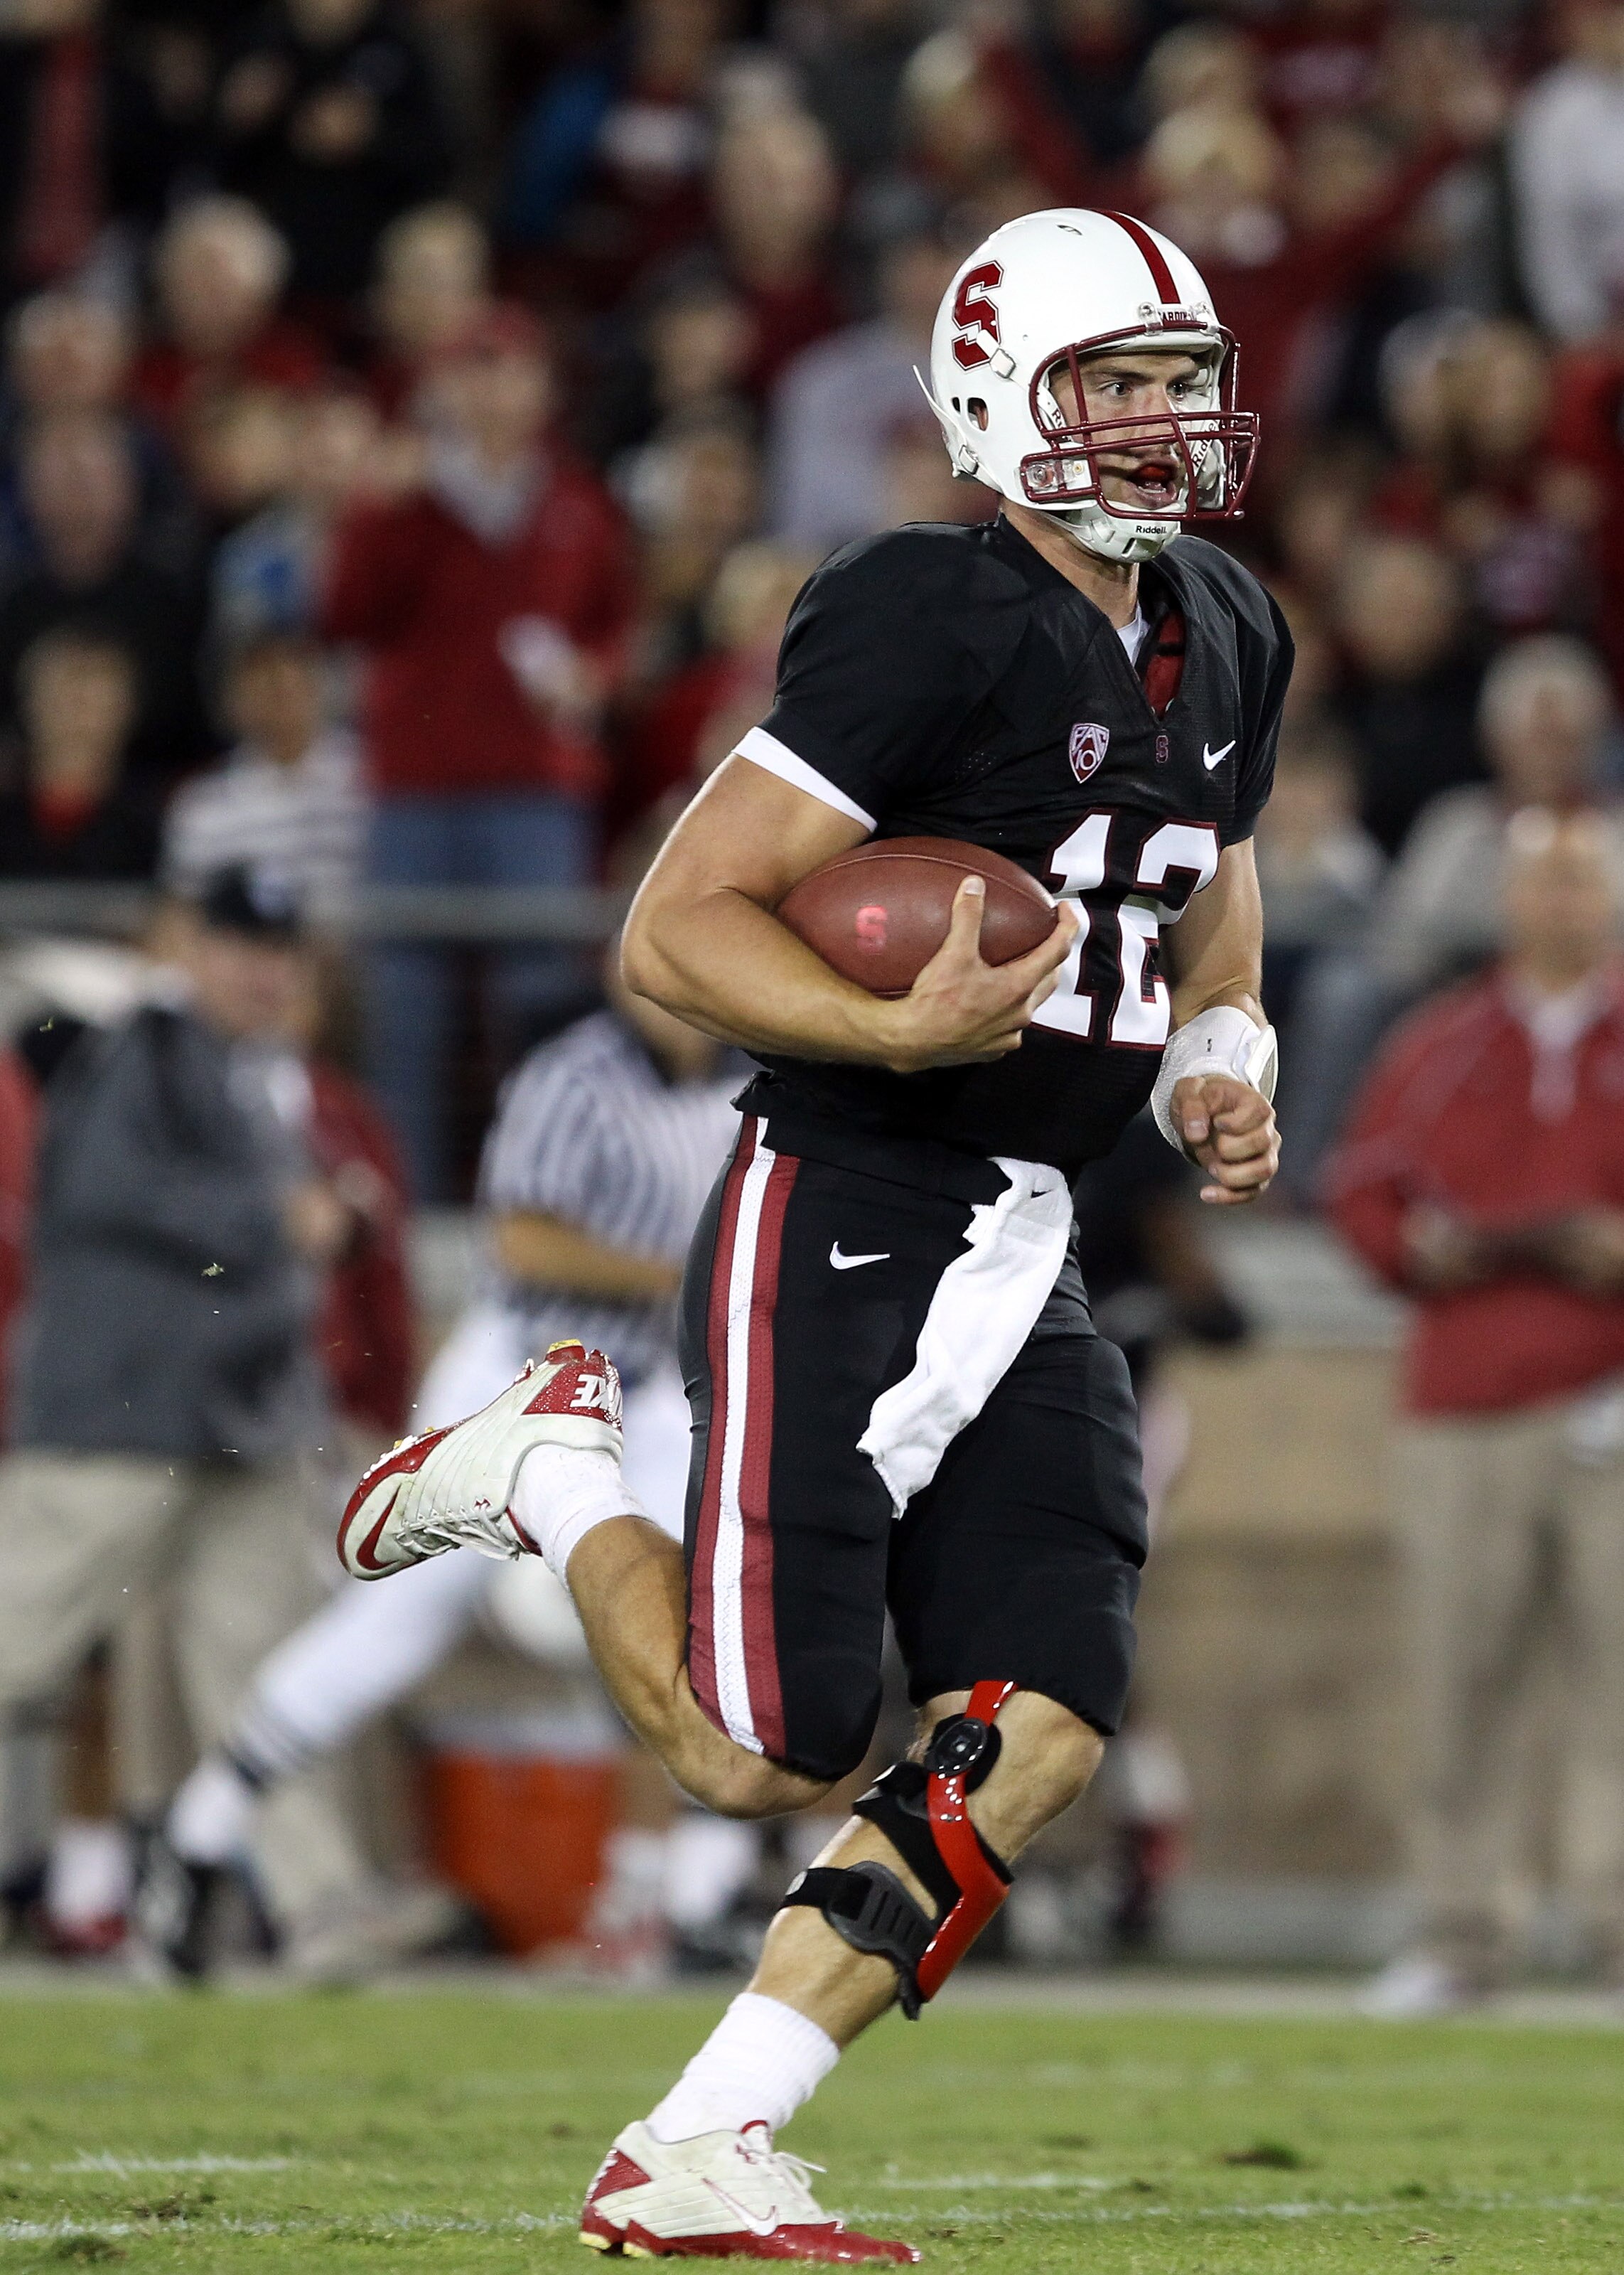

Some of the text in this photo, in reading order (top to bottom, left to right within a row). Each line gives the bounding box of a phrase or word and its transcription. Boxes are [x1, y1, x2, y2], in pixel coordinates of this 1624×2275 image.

[952, 260, 1004, 371] S
[1136, 525, 1167, 534] Riddell
[1075, 749, 1097, 771] 10
[1156, 734, 1169, 764] S
[855, 904, 888, 955] S
[1031, 808, 1221, 1051] 12
